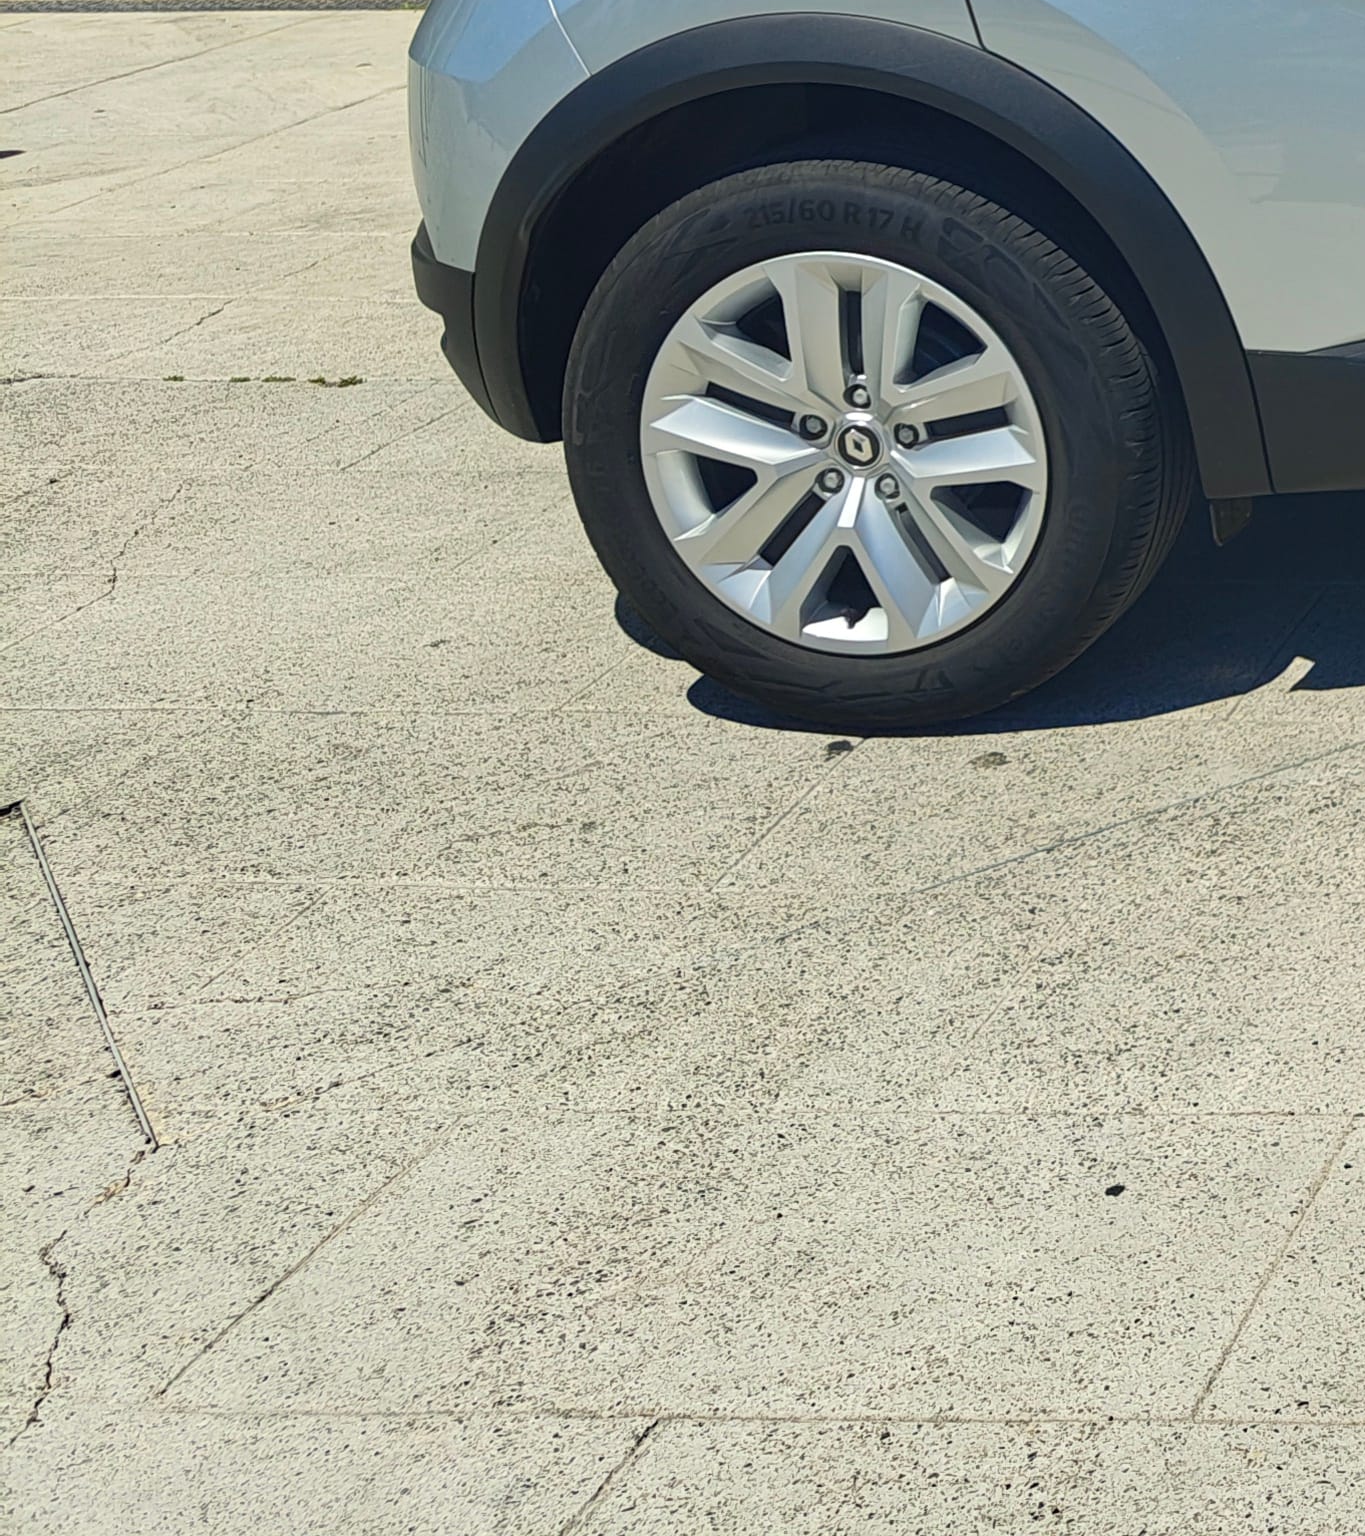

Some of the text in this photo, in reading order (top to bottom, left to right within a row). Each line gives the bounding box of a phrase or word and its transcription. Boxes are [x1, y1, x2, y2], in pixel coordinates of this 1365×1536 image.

[744, 199, 835, 229] 215/60
[844, 201, 862, 227] R
[867, 206, 895, 230] 17
